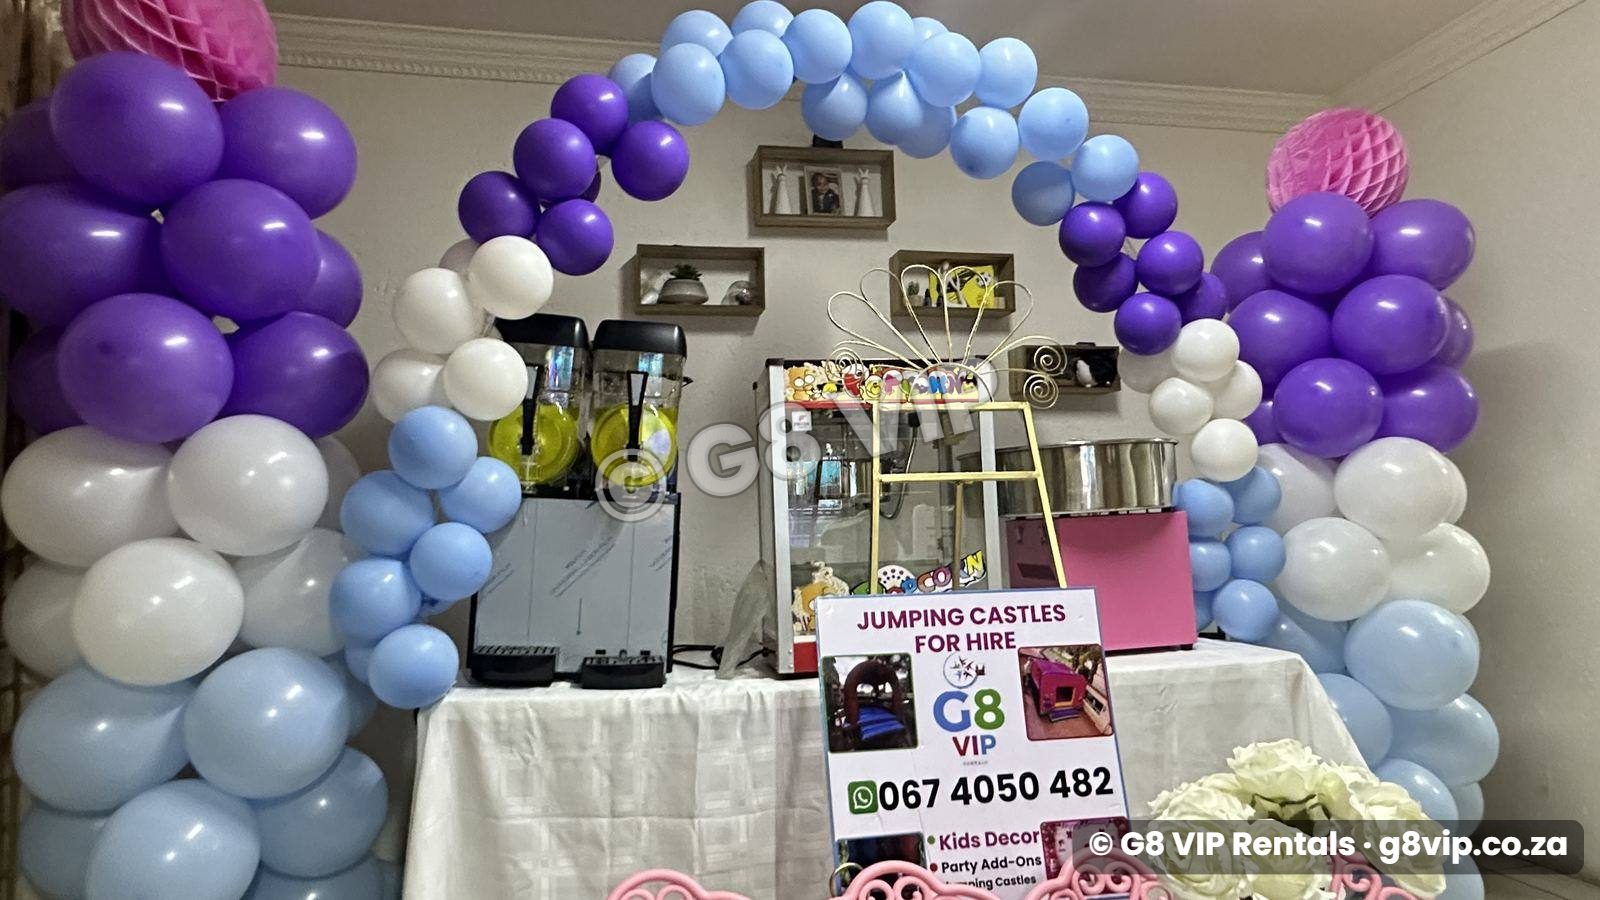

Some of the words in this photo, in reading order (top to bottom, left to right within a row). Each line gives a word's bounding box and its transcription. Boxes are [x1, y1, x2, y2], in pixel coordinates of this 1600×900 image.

[857, 608, 965, 631] JUMPING
[969, 604, 1066, 625] CASTLES
[915, 634, 960, 653] FOR
[966, 631, 1017, 651] HIRE
[933, 688, 1005, 733] G8
[952, 734, 997, 757] VIP
[879, 778, 940, 811] 067
[950, 771, 1040, 805] 4050
[1049, 766, 1114, 798] 482
[939, 832, 981, 851] Kids
[985, 830, 1040, 847] Decor
[941, 860, 978, 875] Party
[981, 855, 1042, 870] Add-Ons
[995, 875, 1037, 887] Castles
